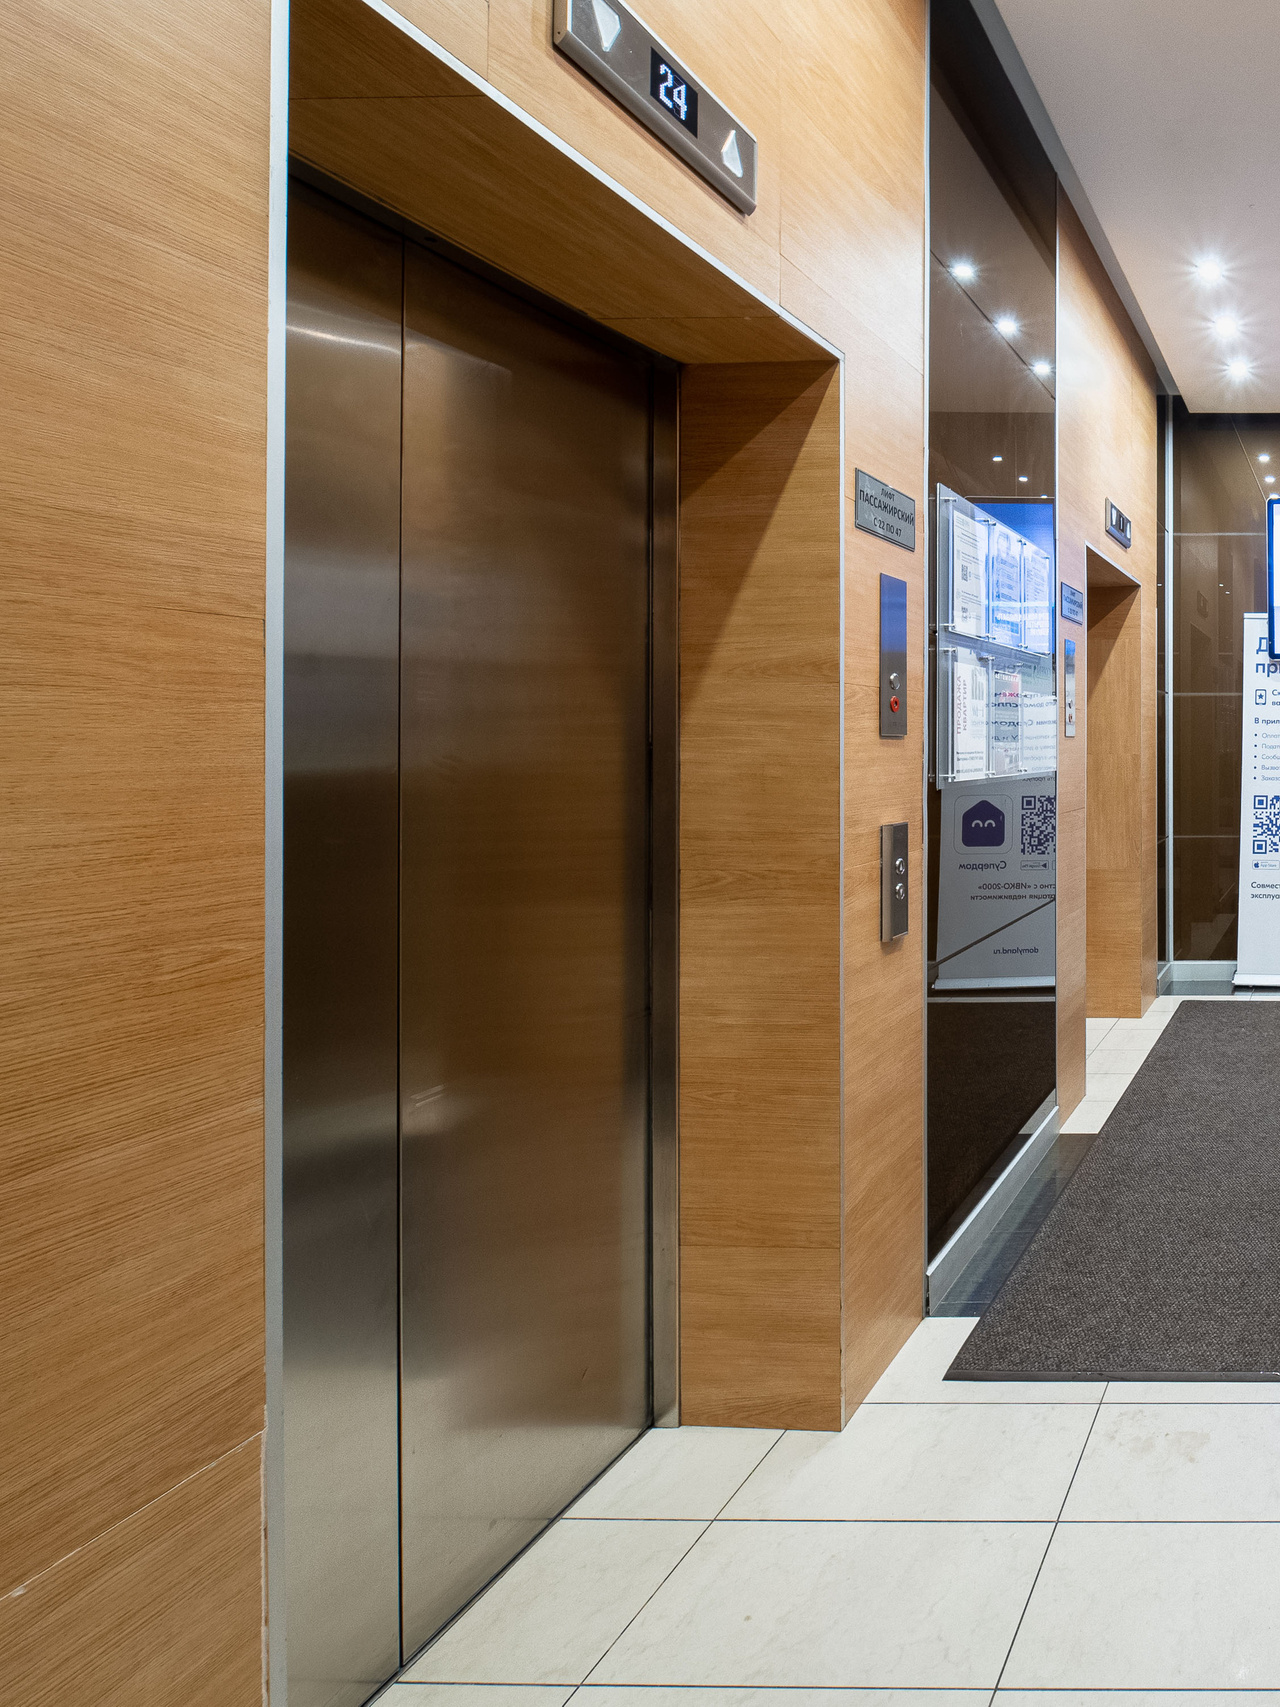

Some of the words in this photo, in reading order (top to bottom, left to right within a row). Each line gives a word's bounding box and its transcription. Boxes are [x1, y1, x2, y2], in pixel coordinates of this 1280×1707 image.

[659, 63, 687, 120] 24
[860, 489, 914, 526] ПАССАЖИРСКИЙ
[881, 488, 895, 501] ЛИФТ
[873, 517, 877, 526] С
[878, 519, 885, 530] 22
[886, 523, 894, 534] ПО
[895, 528, 902, 537] 47
